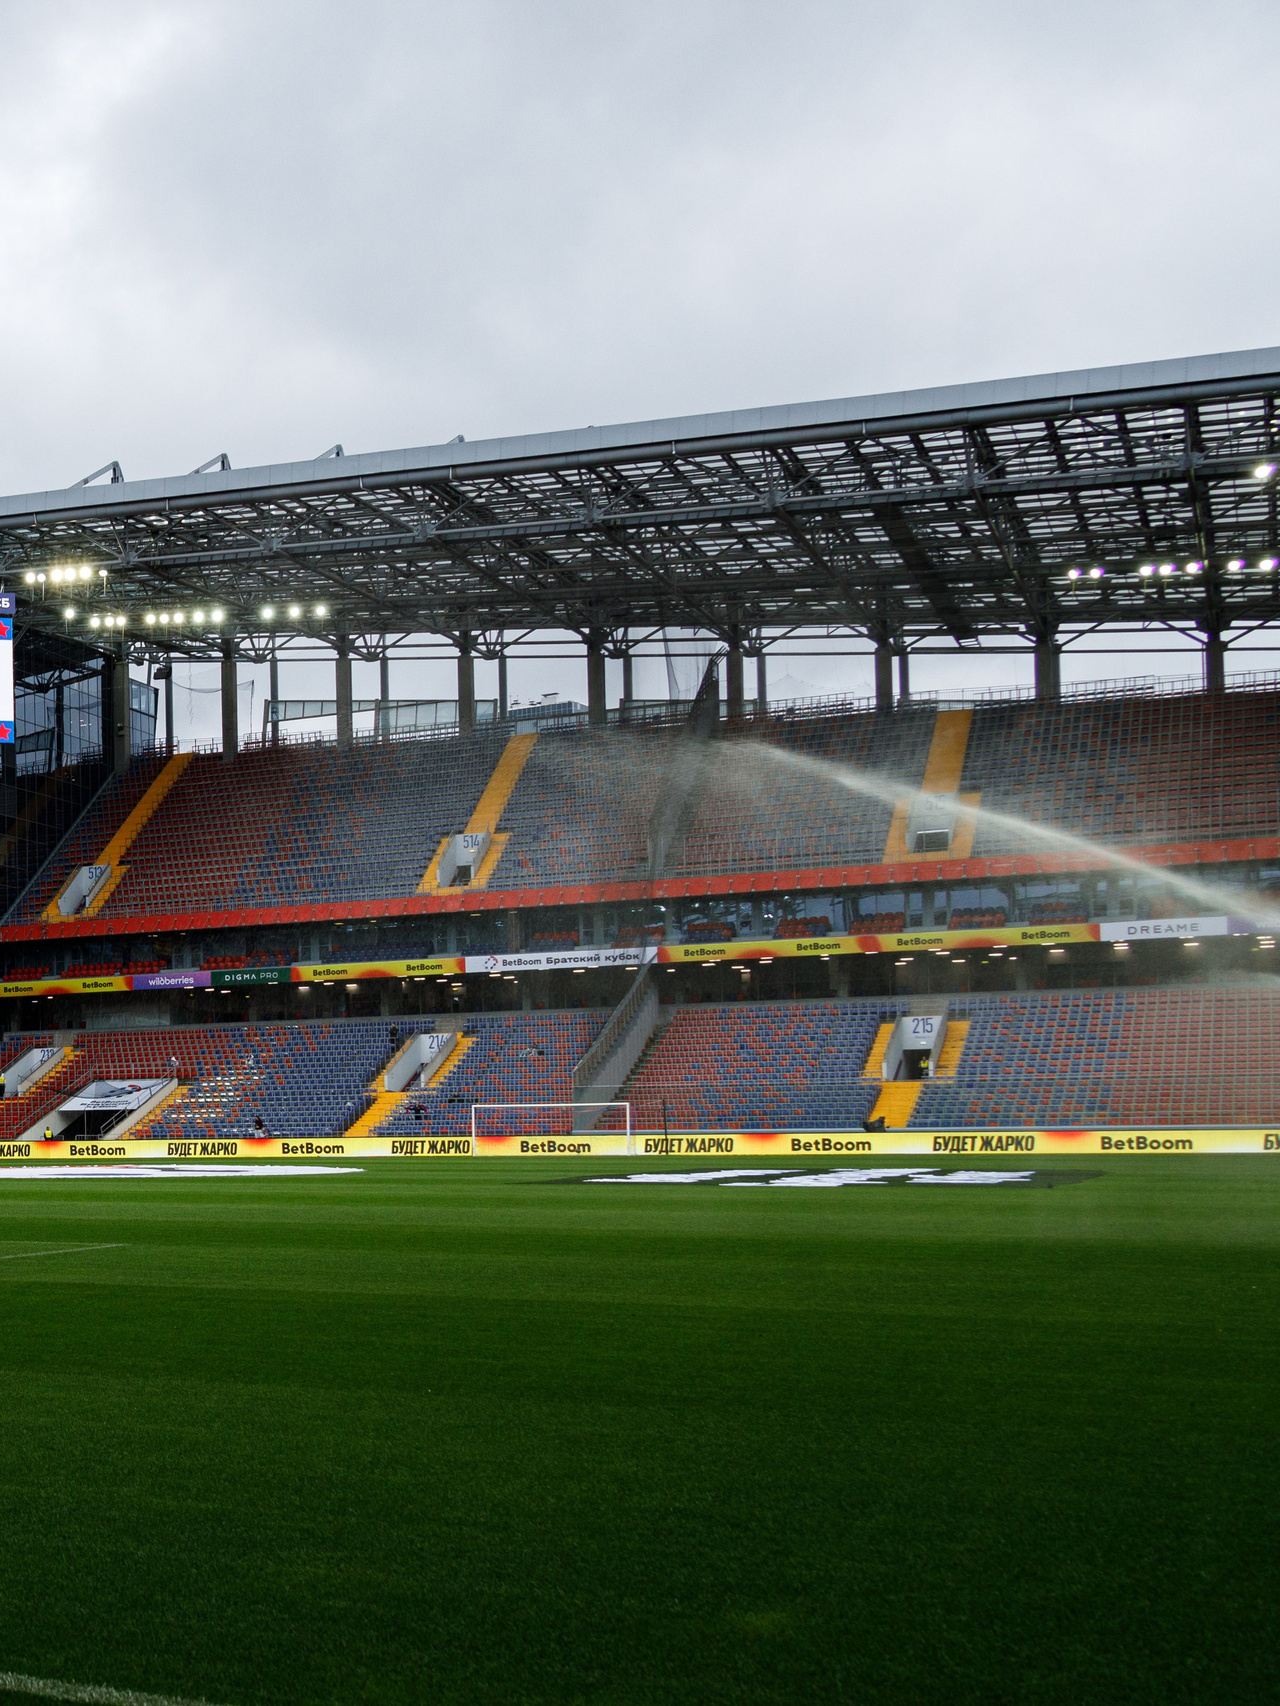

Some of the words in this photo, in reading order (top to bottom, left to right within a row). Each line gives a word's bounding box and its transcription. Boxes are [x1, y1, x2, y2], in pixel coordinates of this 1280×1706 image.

[463, 834, 480, 849] 514
[1021, 930, 1070, 939] BetBoom
[1127, 923, 1199, 935] DREAME
[796, 942, 841, 951] BetBoom
[896, 936, 943, 946] BetBoom
[683, 948, 726, 957] BetBoom
[502, 957, 542, 967] BetBoom
[545, 953, 601, 965] Братский
[605, 951, 640, 963] кубок
[312, 967, 348, 976] BetBoom
[406, 963, 443, 972] BetBoom
[148, 975, 194, 986] wildberries
[224, 973, 256, 982] DIGMA
[260, 971, 279, 980] PRO
[3, 985, 33, 994] BetBoom
[82, 981, 113, 989] BetBoom
[912, 1017, 934, 1034] 215
[428, 1034, 447, 1050] 214
[281, 1142, 345, 1154] BetBoom
[391, 1140, 427, 1156] БУДЕТ
[427, 1140, 471, 1154] ЖАРКО
[520, 1140, 591, 1153] BetBoom
[644, 1138, 685, 1154] БУДЕТ
[686, 1138, 734, 1153] ЖАРКО
[791, 1138, 871, 1151] BetBoom
[932, 1136, 978, 1153] БУДЕТ
[979, 1135, 1035, 1151] ЖАРКО
[1101, 1136, 1193, 1150] BetBoom
[70, 1145, 126, 1156] BetBoom
[167, 1142, 199, 1157] БУДЕТ
[199, 1142, 238, 1156] ЖАРКО
